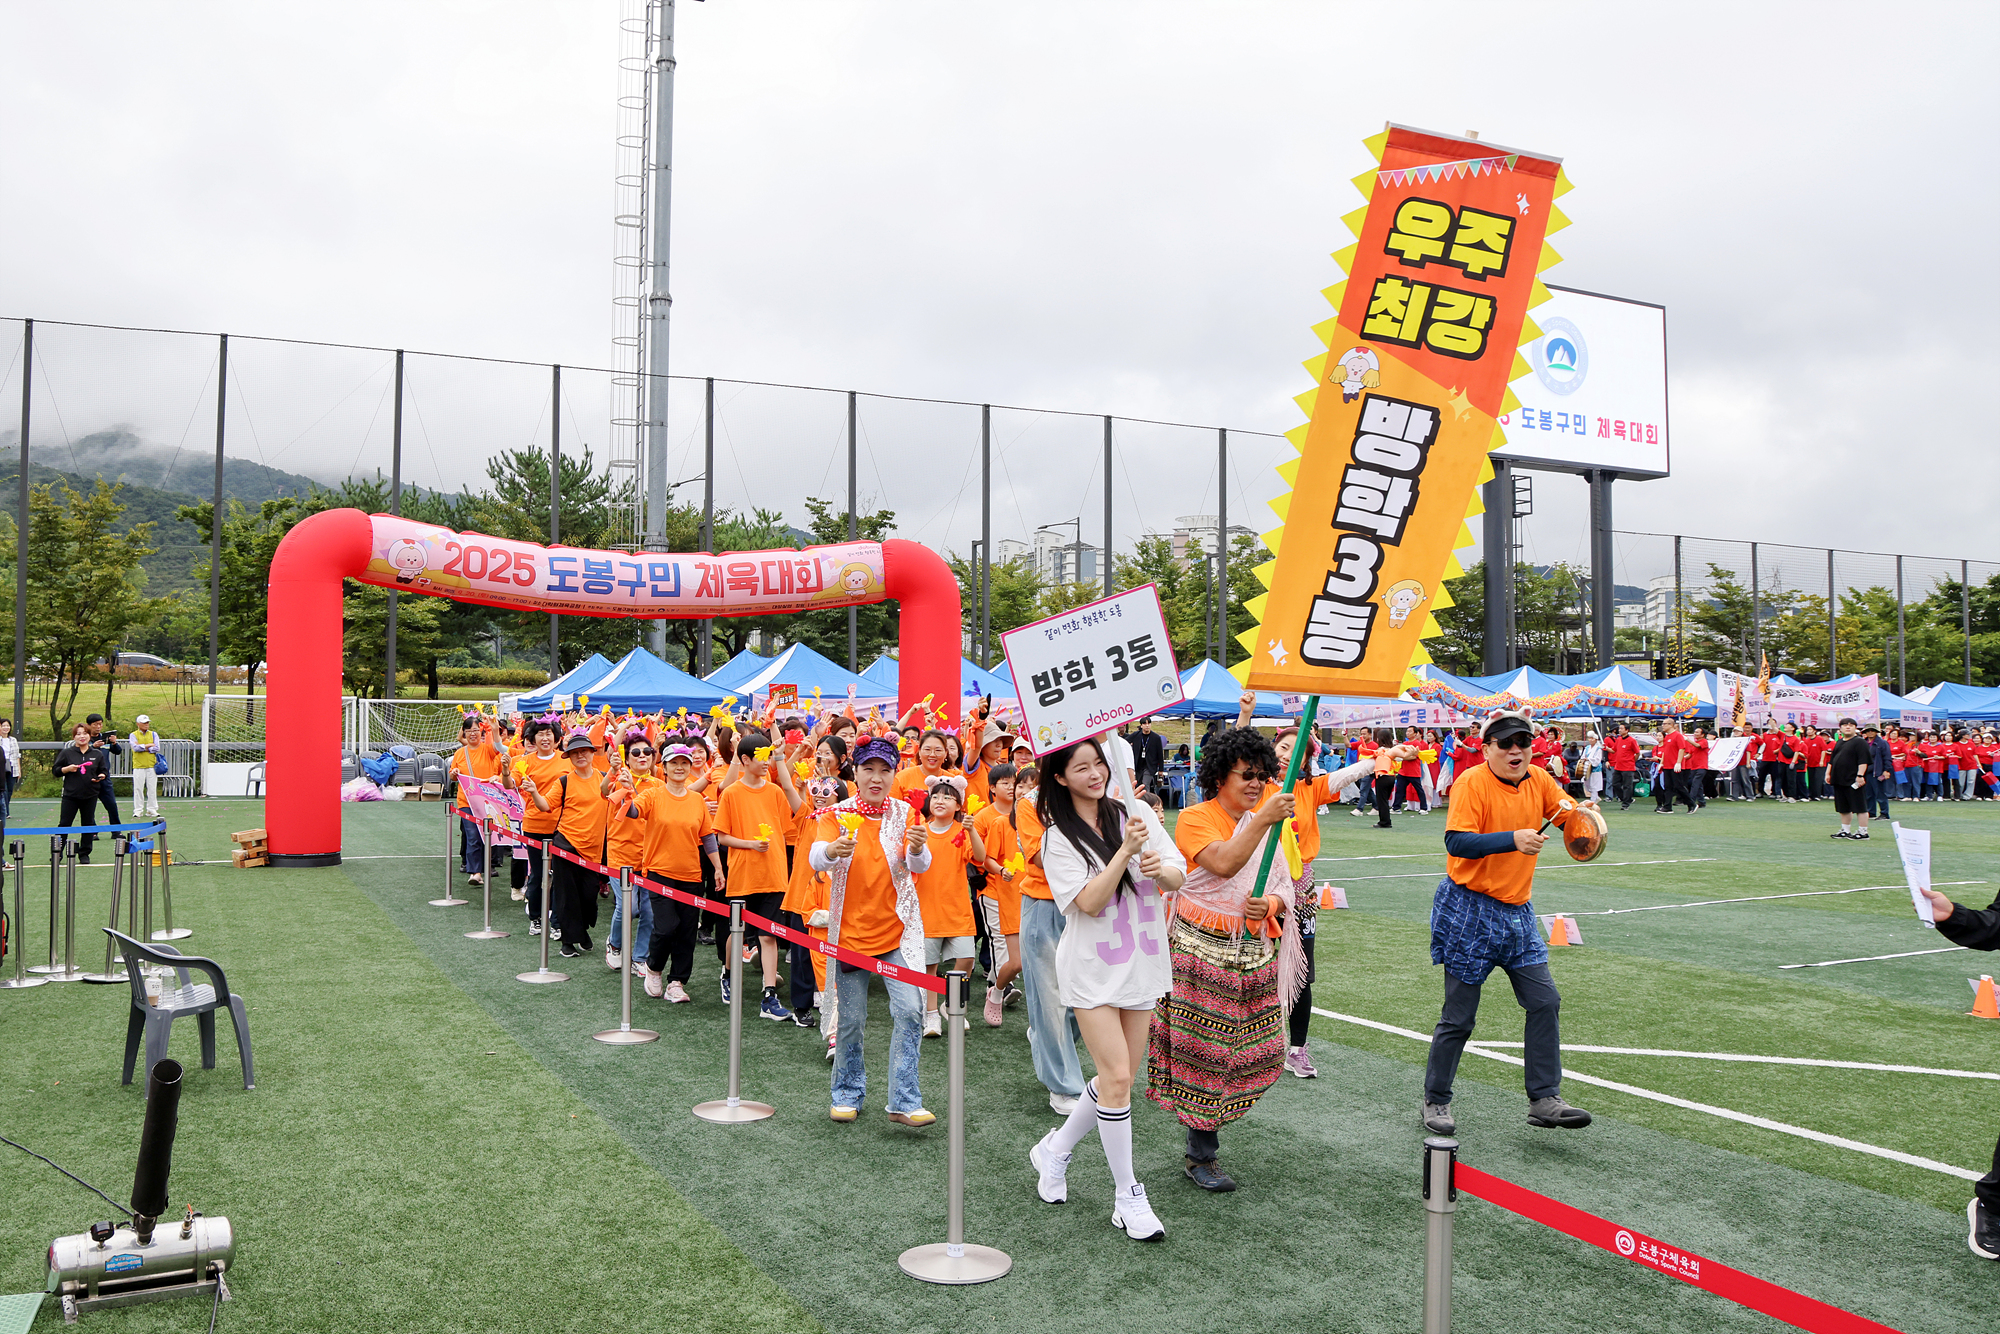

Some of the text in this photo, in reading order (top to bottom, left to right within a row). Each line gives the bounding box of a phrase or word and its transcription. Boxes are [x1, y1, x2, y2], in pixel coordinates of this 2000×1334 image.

[1386, 199, 1514, 278] 우주
[1361, 276, 1495, 357] 최강
[1522, 407, 1586, 436] 도봉구민
[1597, 416, 1658, 445] 체육대회
[1302, 396, 1436, 665] 방학3동
[443, 541, 824, 598] 2025 도봉구민 체육대회
[1044, 603, 1122, 641] 같이 변화, 행복한 도봉
[1031, 655, 1097, 708] 방학
[1105, 633, 1159, 682] 3동
[1085, 703, 1134, 728] dobong
[1399, 708, 1457, 724] 쌍문1동
[1302, 916, 1316, 935] 30
[1638, 1251, 1700, 1280] Dobong Sports Council
[1639, 1241, 1700, 1273] 도봉구체육회
